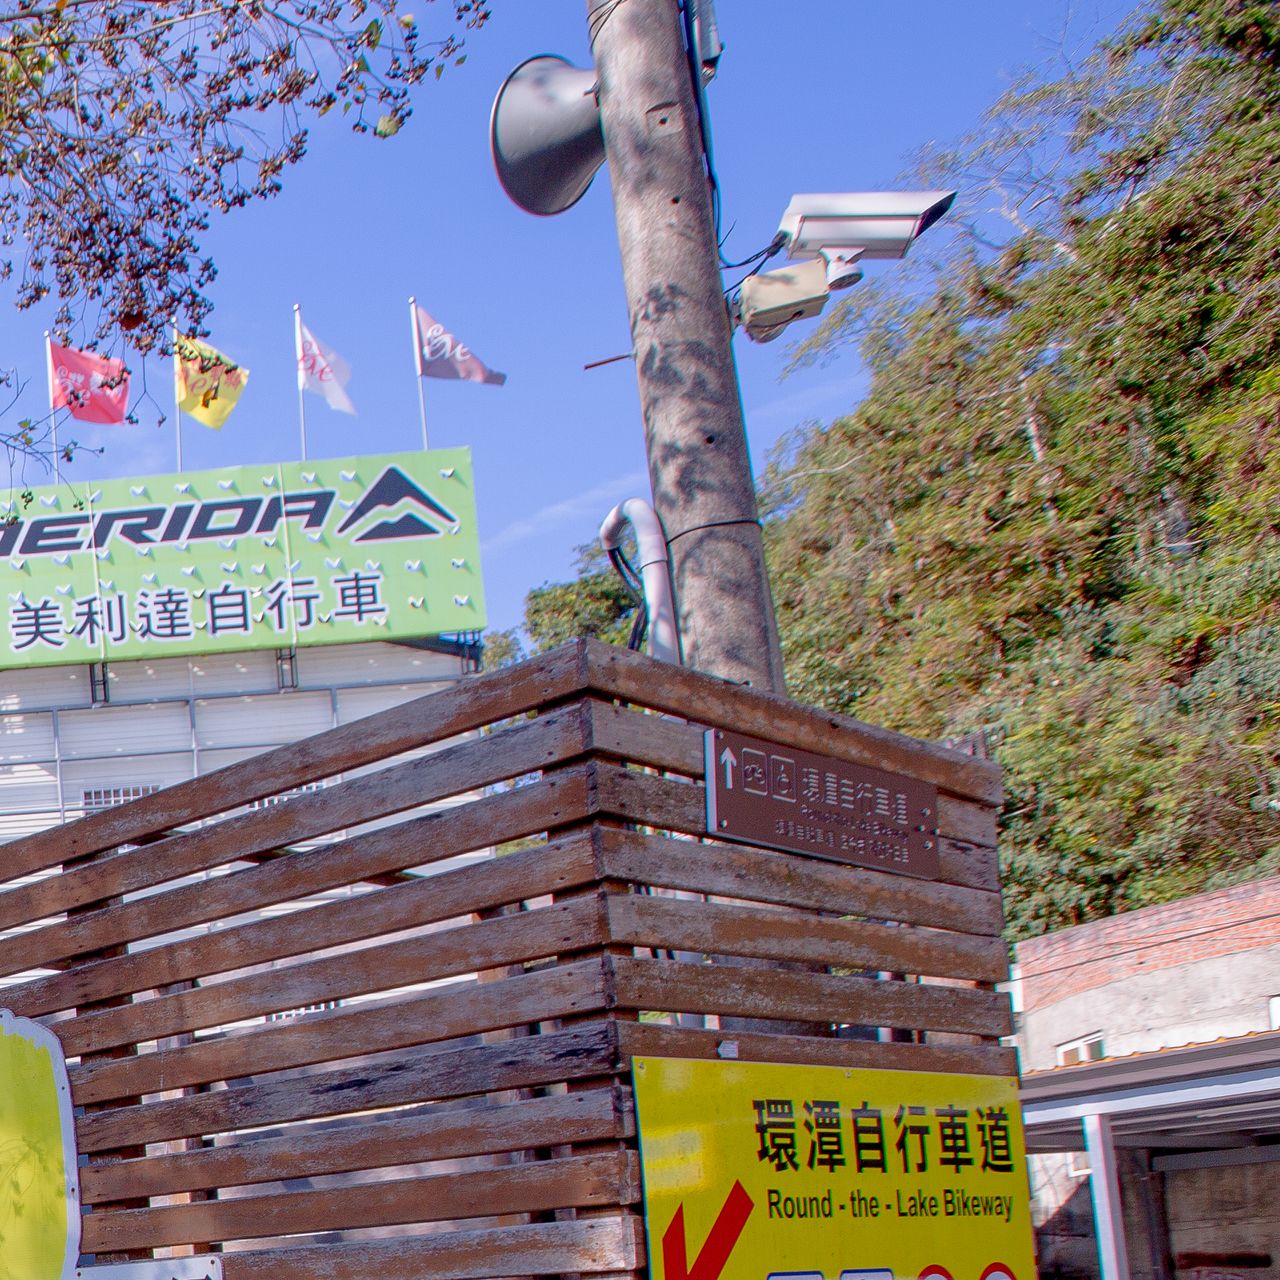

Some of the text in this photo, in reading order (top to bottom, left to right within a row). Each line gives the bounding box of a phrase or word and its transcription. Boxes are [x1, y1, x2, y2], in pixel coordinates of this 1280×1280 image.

[10, 569, 388, 652] 美利達自行車
[752, 1098, 1015, 1175] 環潭自行車道
[767, 1188, 833, 1219] Round
[850, 1190, 880, 1217] the
[896, 1189, 938, 1217] Lake
[944, 1188, 1014, 1223] Bikeway
